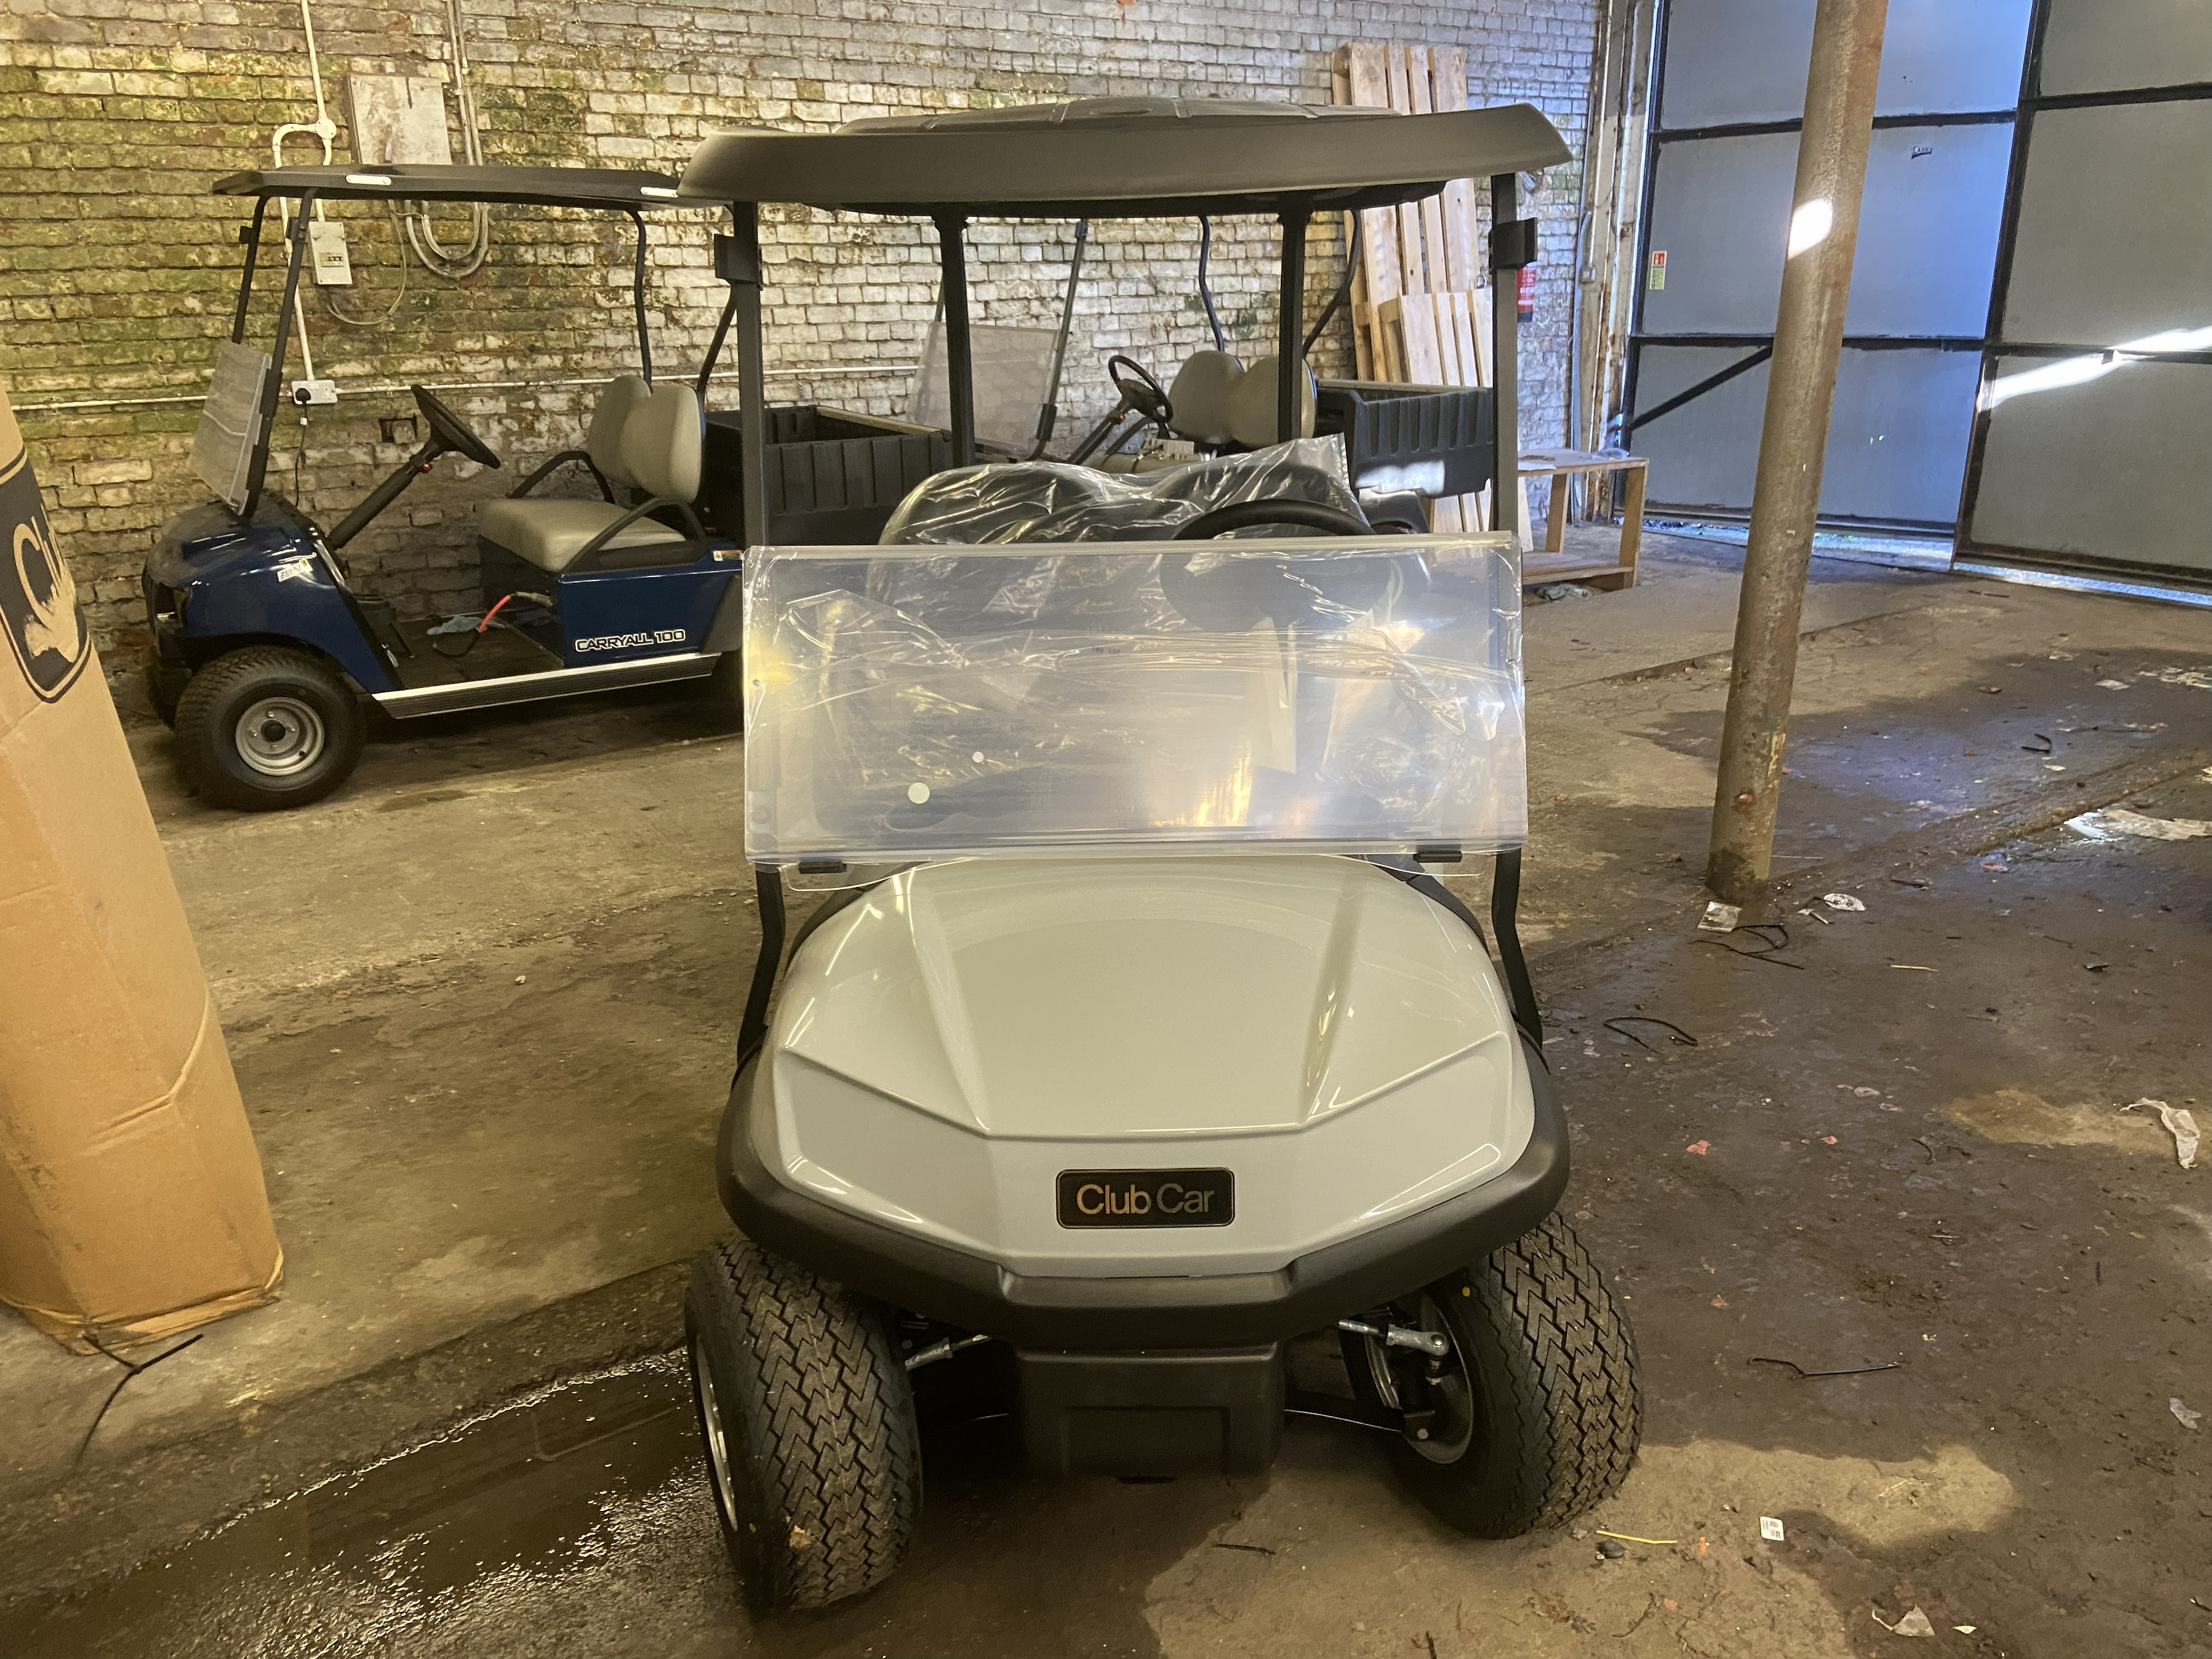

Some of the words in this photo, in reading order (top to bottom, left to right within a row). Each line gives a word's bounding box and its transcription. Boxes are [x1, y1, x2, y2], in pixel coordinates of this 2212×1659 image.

[575, 633, 654, 652] CARRYALL
[654, 629, 686, 644] 100
[1076, 1183, 1152, 1215] Club
[1156, 1183, 1215, 1214] Car
